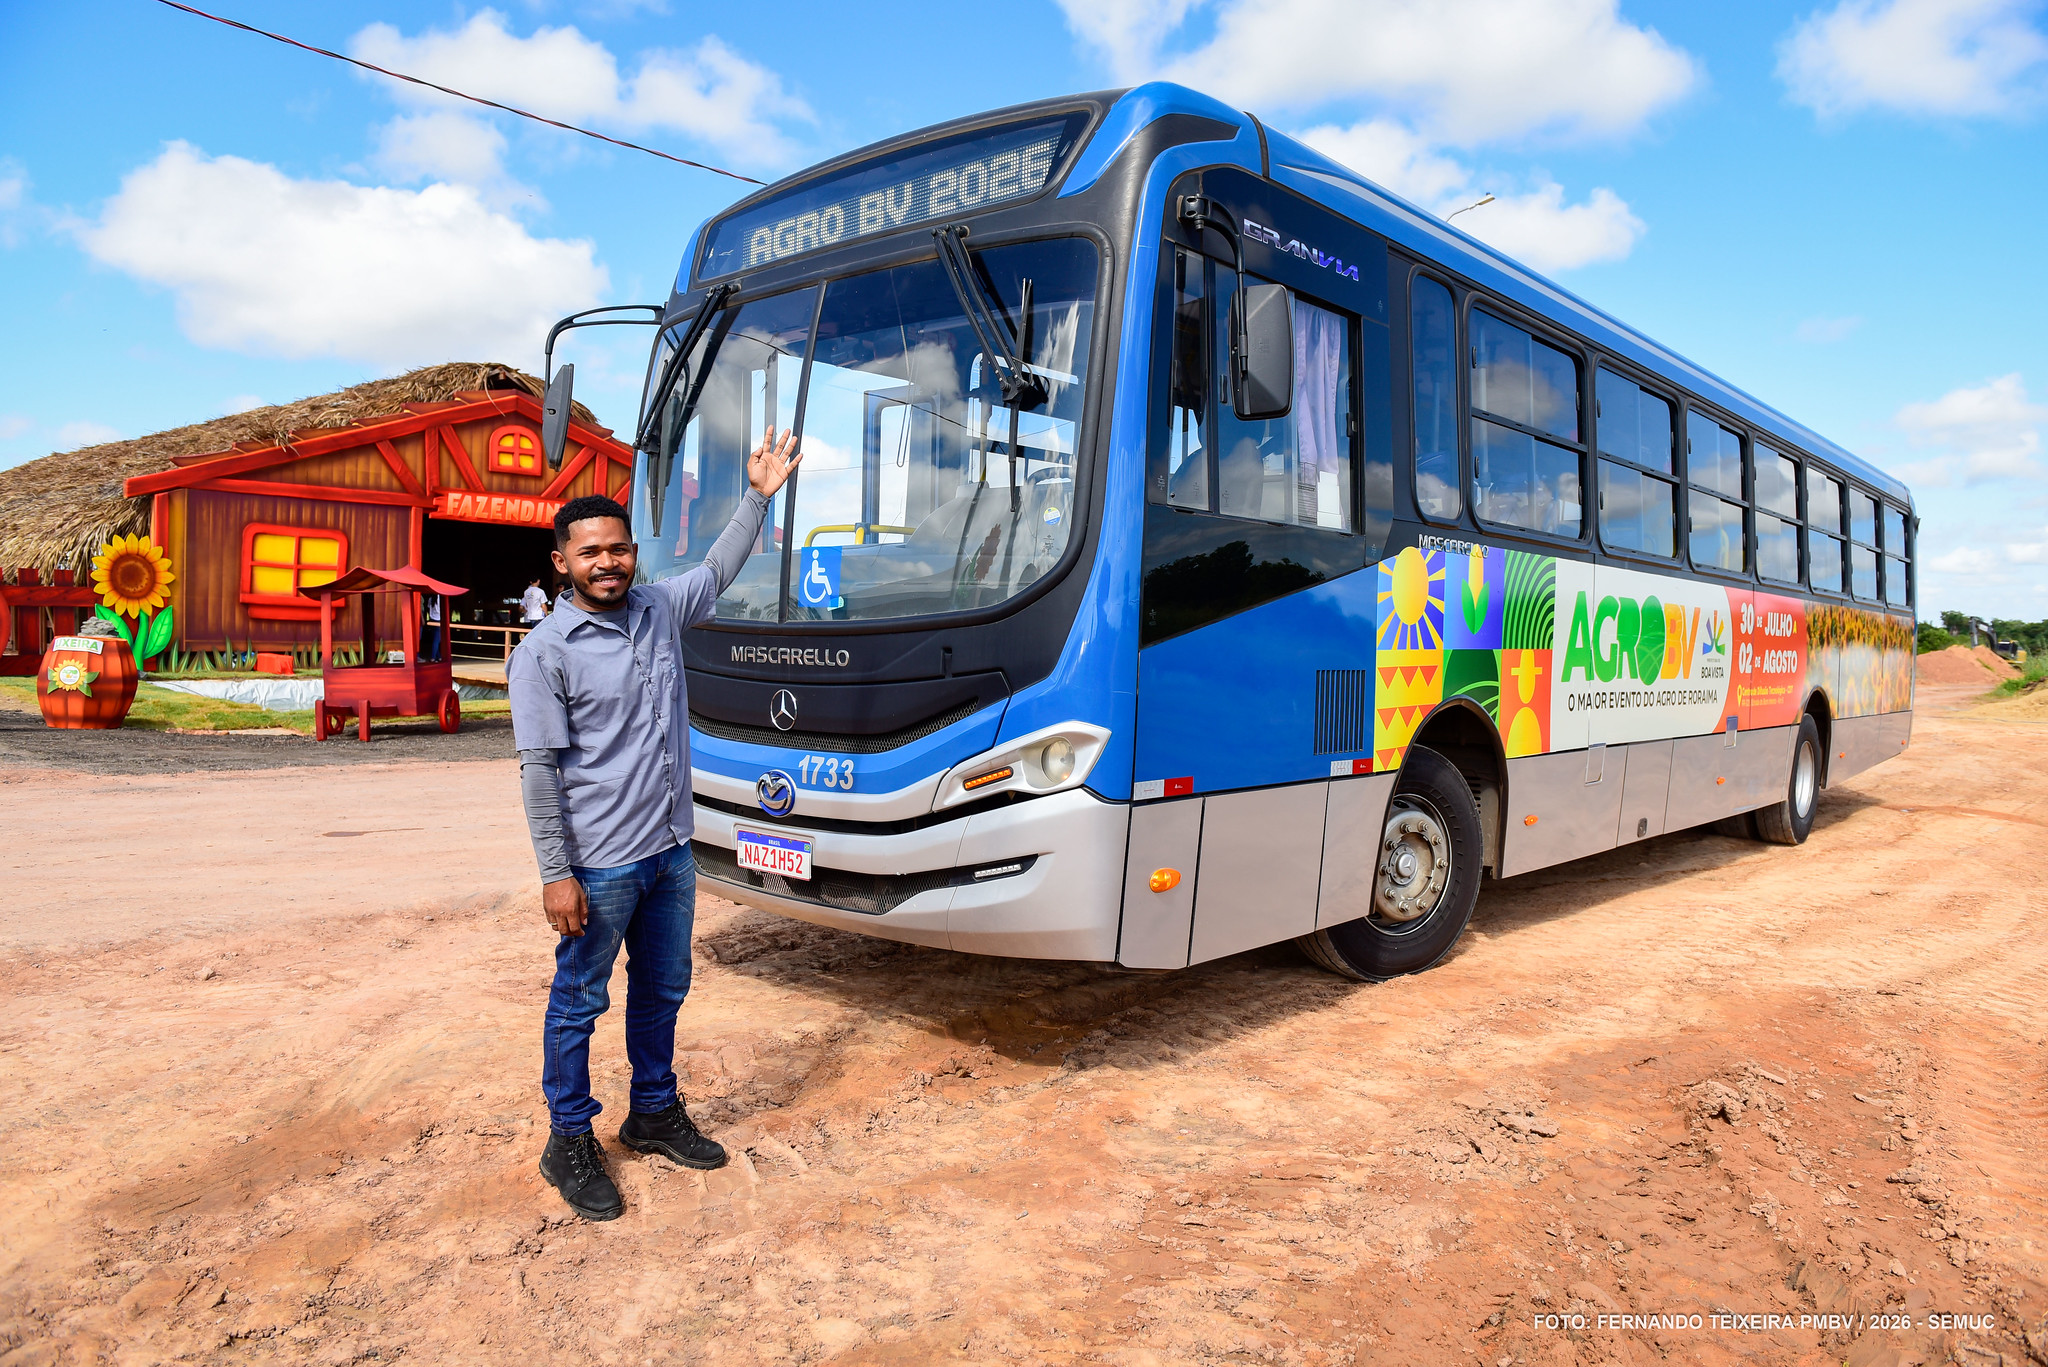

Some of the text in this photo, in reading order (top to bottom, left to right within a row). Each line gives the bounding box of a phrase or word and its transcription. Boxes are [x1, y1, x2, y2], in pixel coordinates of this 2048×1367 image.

[750, 139, 1052, 266] AGRO BV 2026
[1243, 218, 1359, 281] GRANVIA
[447, 493, 565, 523] FAZENDIN
[1740, 602, 1755, 634] 30
[1756, 616, 1763, 628] DE
[1764, 611, 1793, 638] JULHO
[731, 645, 850, 667] MASCARELLO
[1738, 642, 1798, 674] 02 DE AGOSTO
[1701, 666, 1724, 679] BOA VISTA
[1568, 693, 1575, 712] O
[1609, 691, 1642, 709] EVENTO
[1643, 691, 1654, 707] DO
[1655, 690, 1676, 706] AGRO
[1677, 690, 1687, 705] DE
[1687, 689, 1718, 705] RORAIMA
[798, 754, 855, 790] 1733
[744, 843, 803, 875] NAZ1H52
